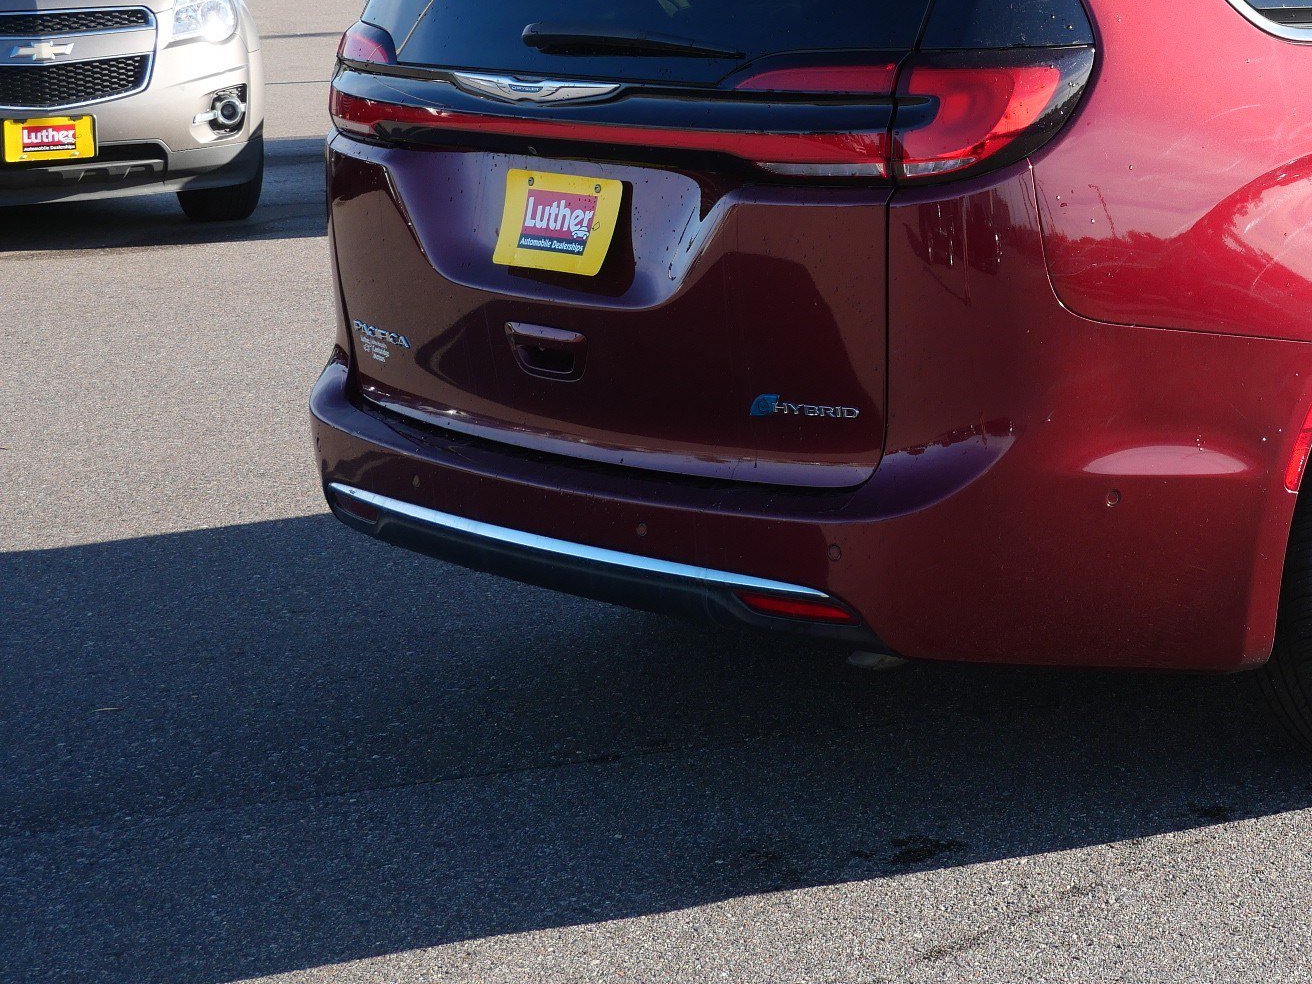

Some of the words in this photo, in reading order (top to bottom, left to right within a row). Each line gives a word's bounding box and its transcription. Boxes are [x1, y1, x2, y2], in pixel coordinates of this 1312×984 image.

[23, 128, 75, 143] Luther
[525, 197, 594, 232] Luther
[520, 237, 552, 248] Automobile
[552, 241, 584, 252] Dealerships
[772, 402, 860, 418] HYBRID
